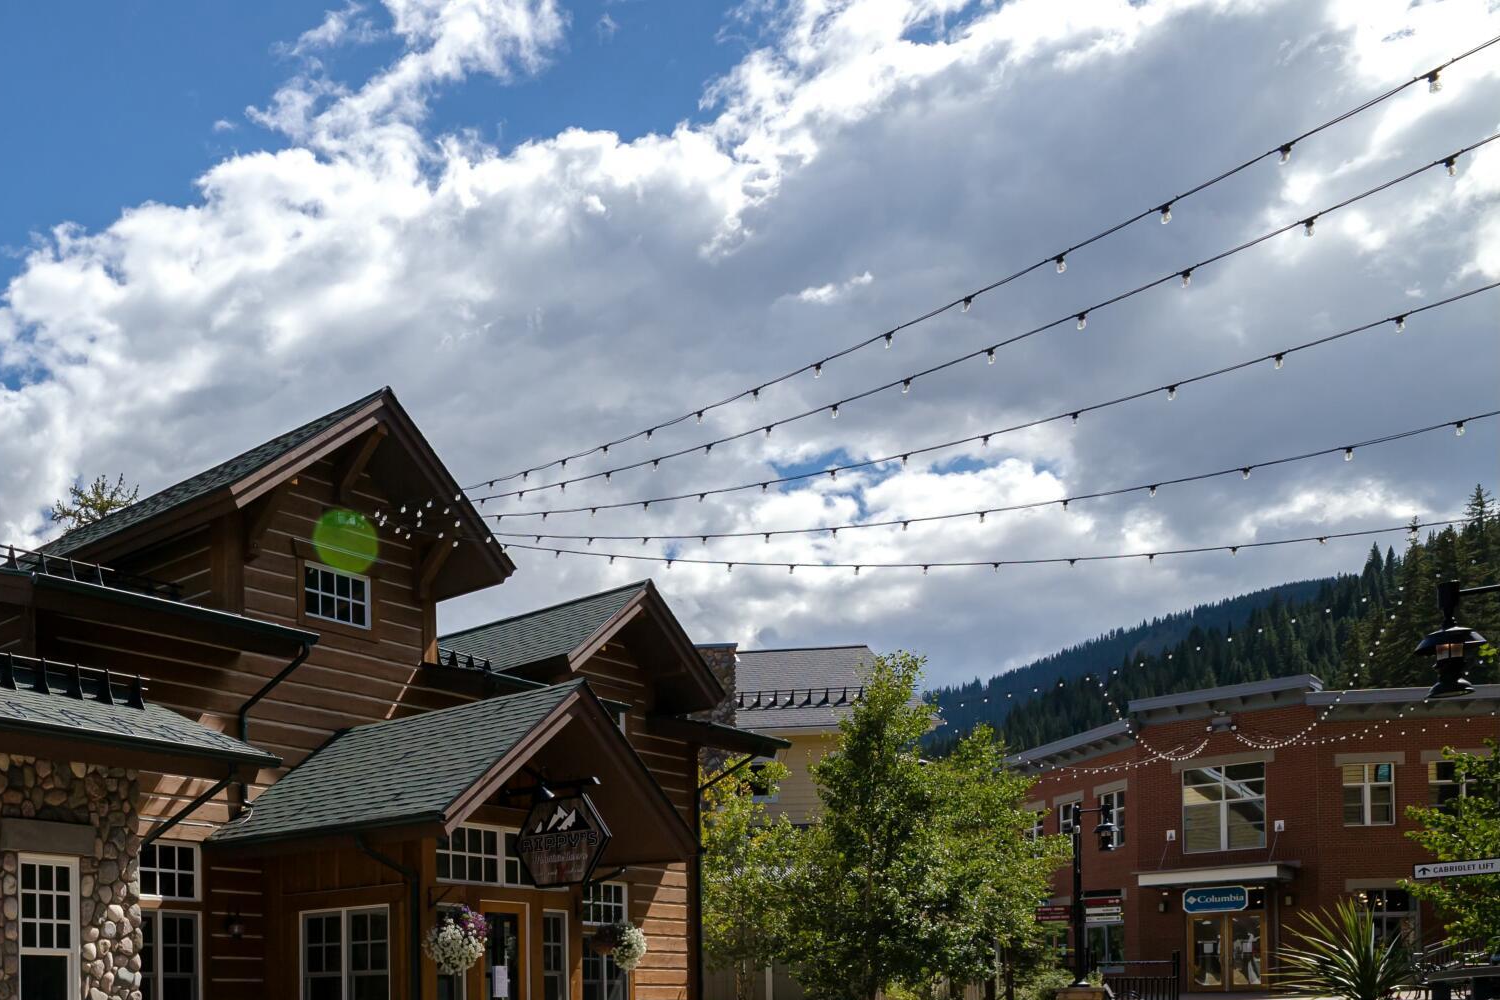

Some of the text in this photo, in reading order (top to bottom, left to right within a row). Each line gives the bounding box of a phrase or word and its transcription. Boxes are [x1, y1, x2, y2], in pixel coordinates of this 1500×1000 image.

[1432, 862, 1495, 874] CABRIOLET LIFT
[1197, 893, 1245, 904] Columbia
